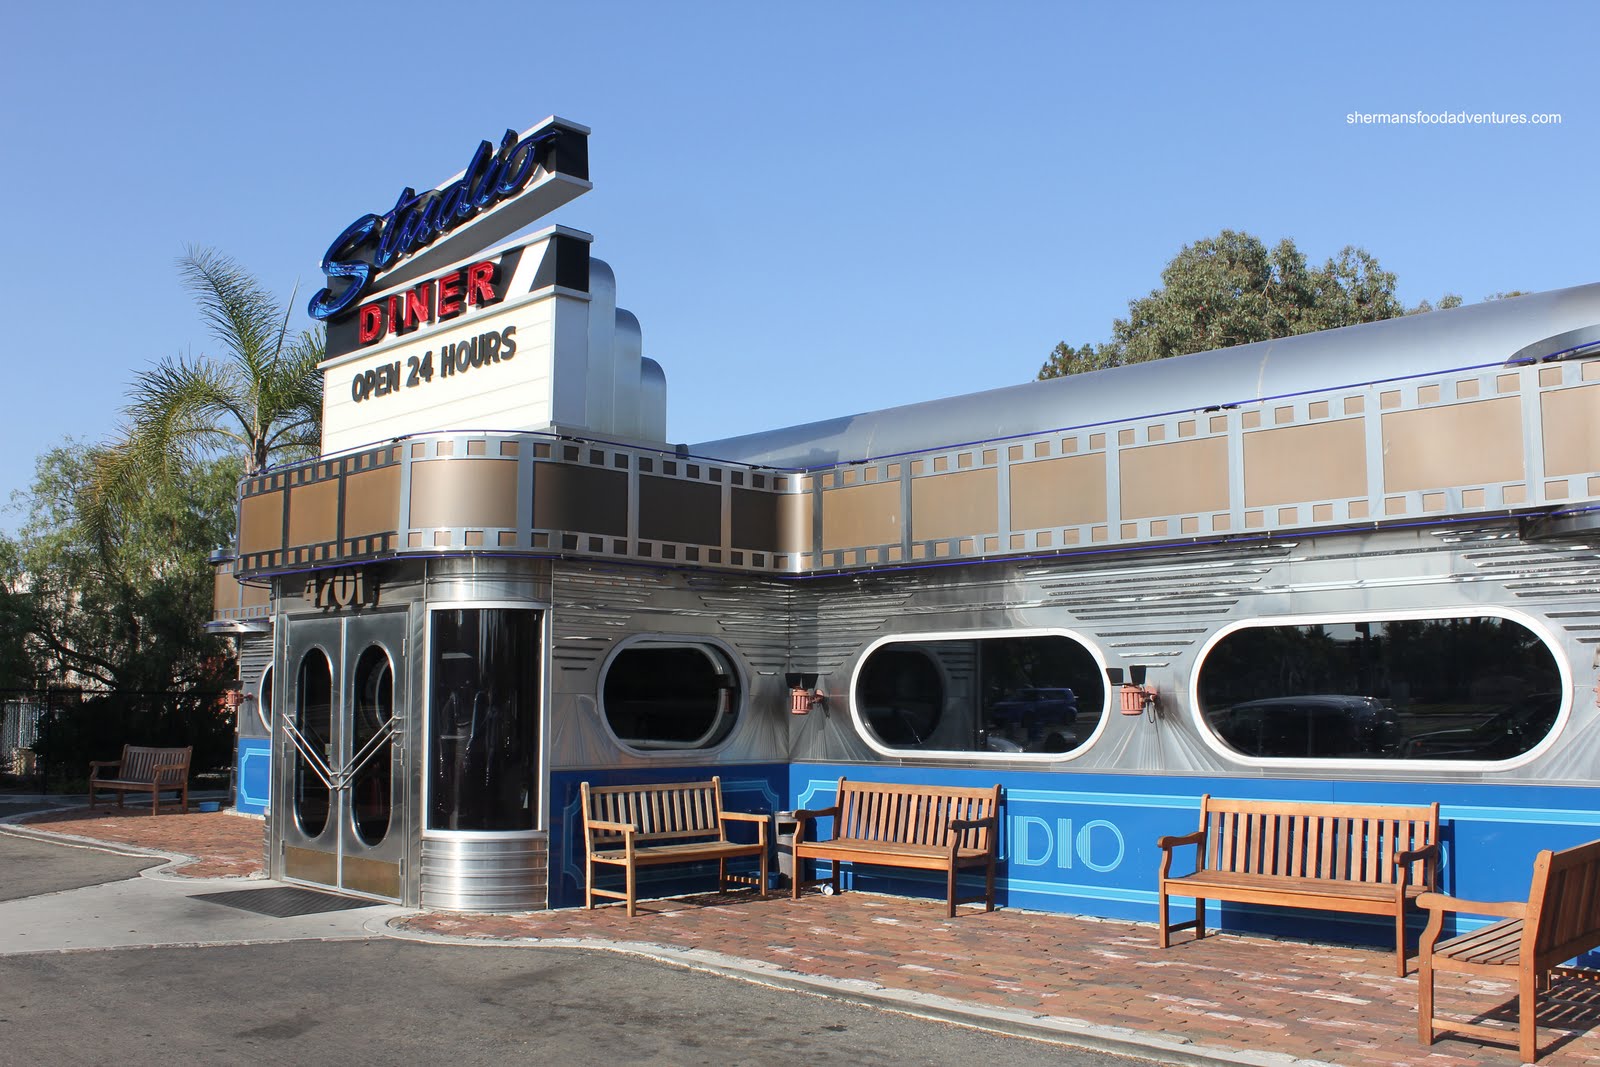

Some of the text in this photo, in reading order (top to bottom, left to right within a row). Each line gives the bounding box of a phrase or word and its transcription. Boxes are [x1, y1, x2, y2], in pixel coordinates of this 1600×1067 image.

[307, 128, 557, 321] Studio
[358, 260, 498, 345] DINER
[351, 325, 518, 404] OPEN 24 HOURS
